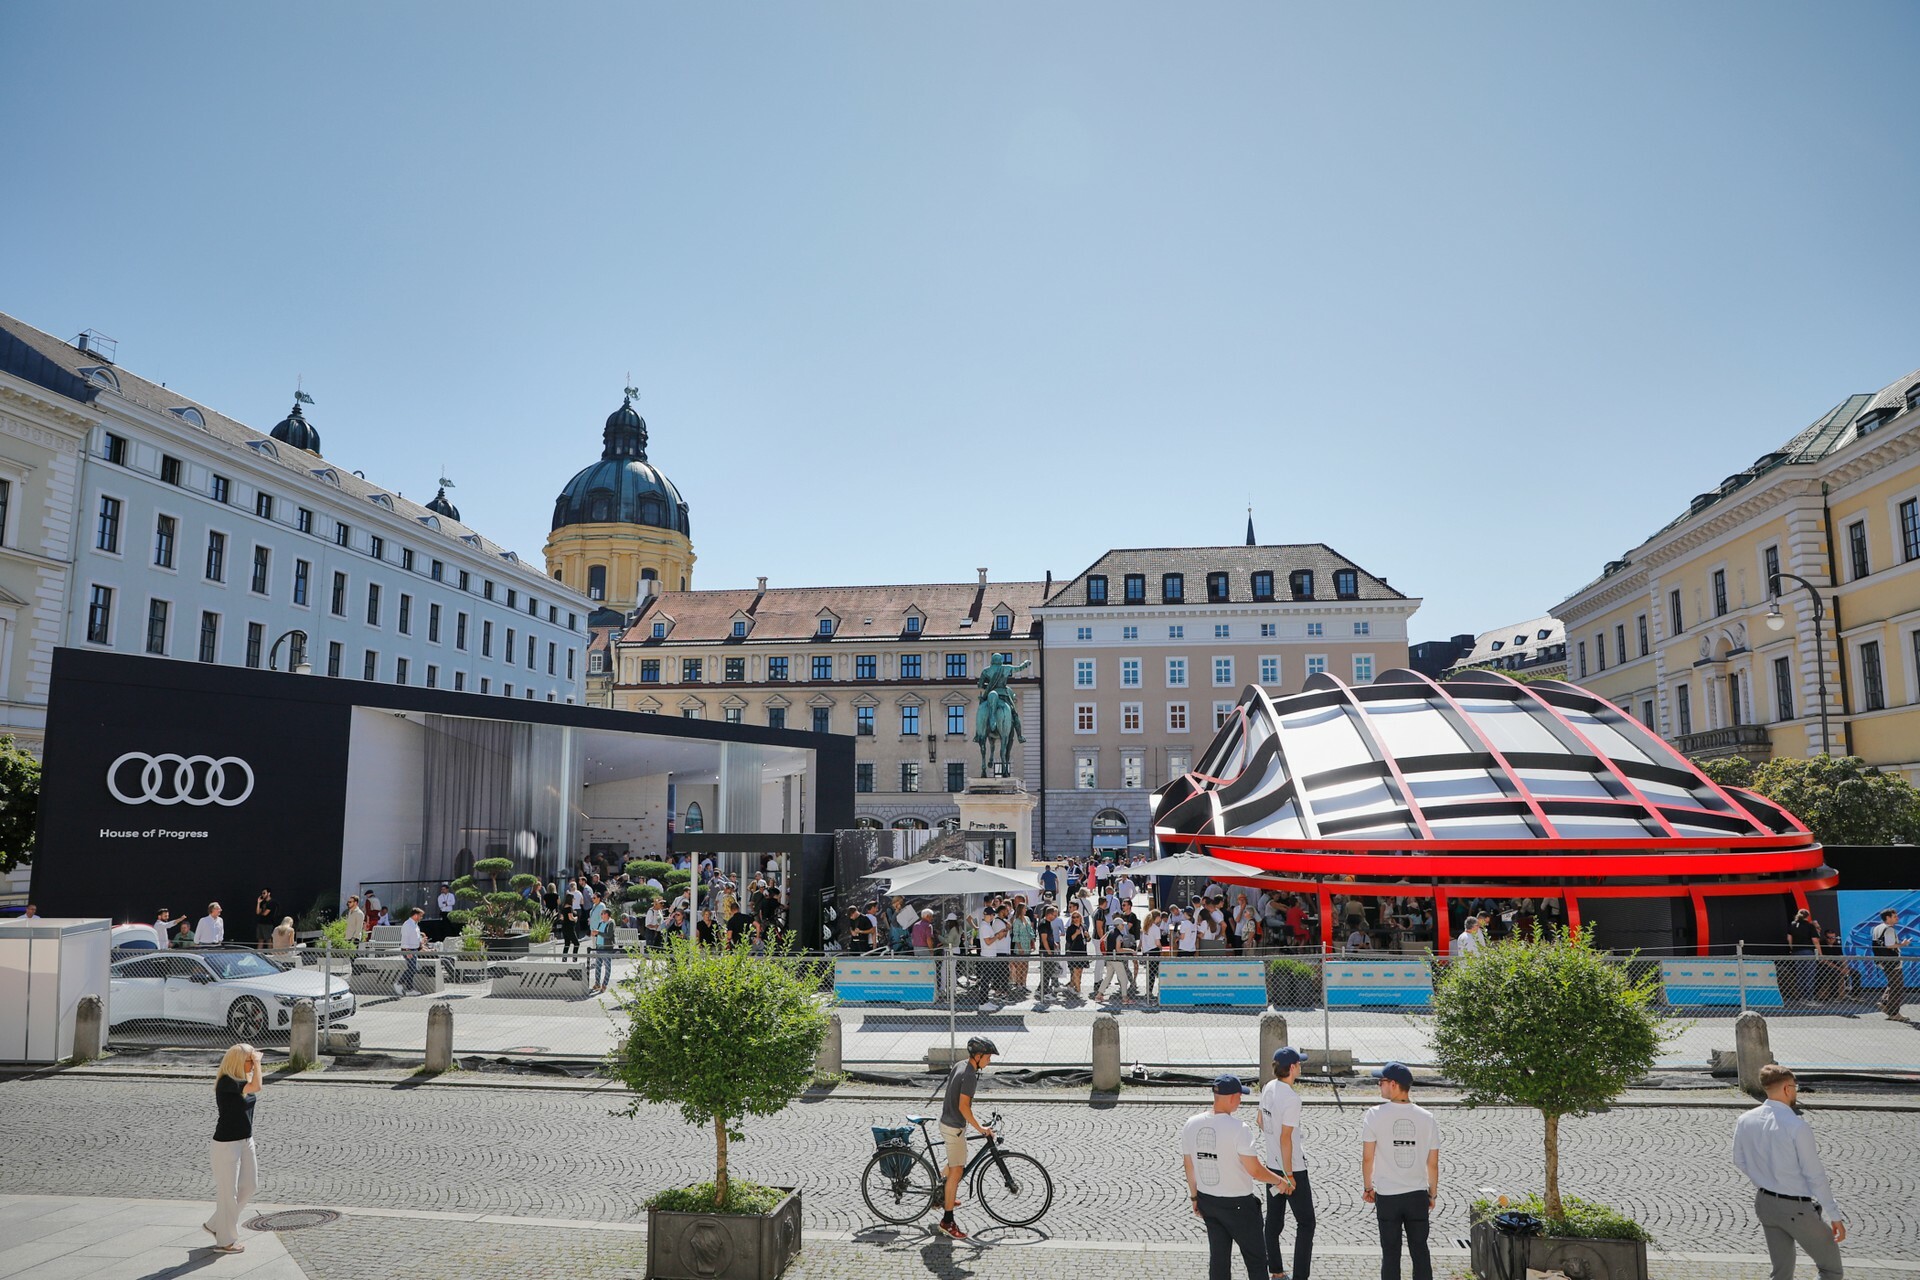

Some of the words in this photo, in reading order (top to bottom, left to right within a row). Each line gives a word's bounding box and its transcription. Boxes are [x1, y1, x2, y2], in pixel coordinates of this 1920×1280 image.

[99, 828, 140, 838] House
[142, 828, 156, 838] of
[158, 829, 209, 840] Progress
